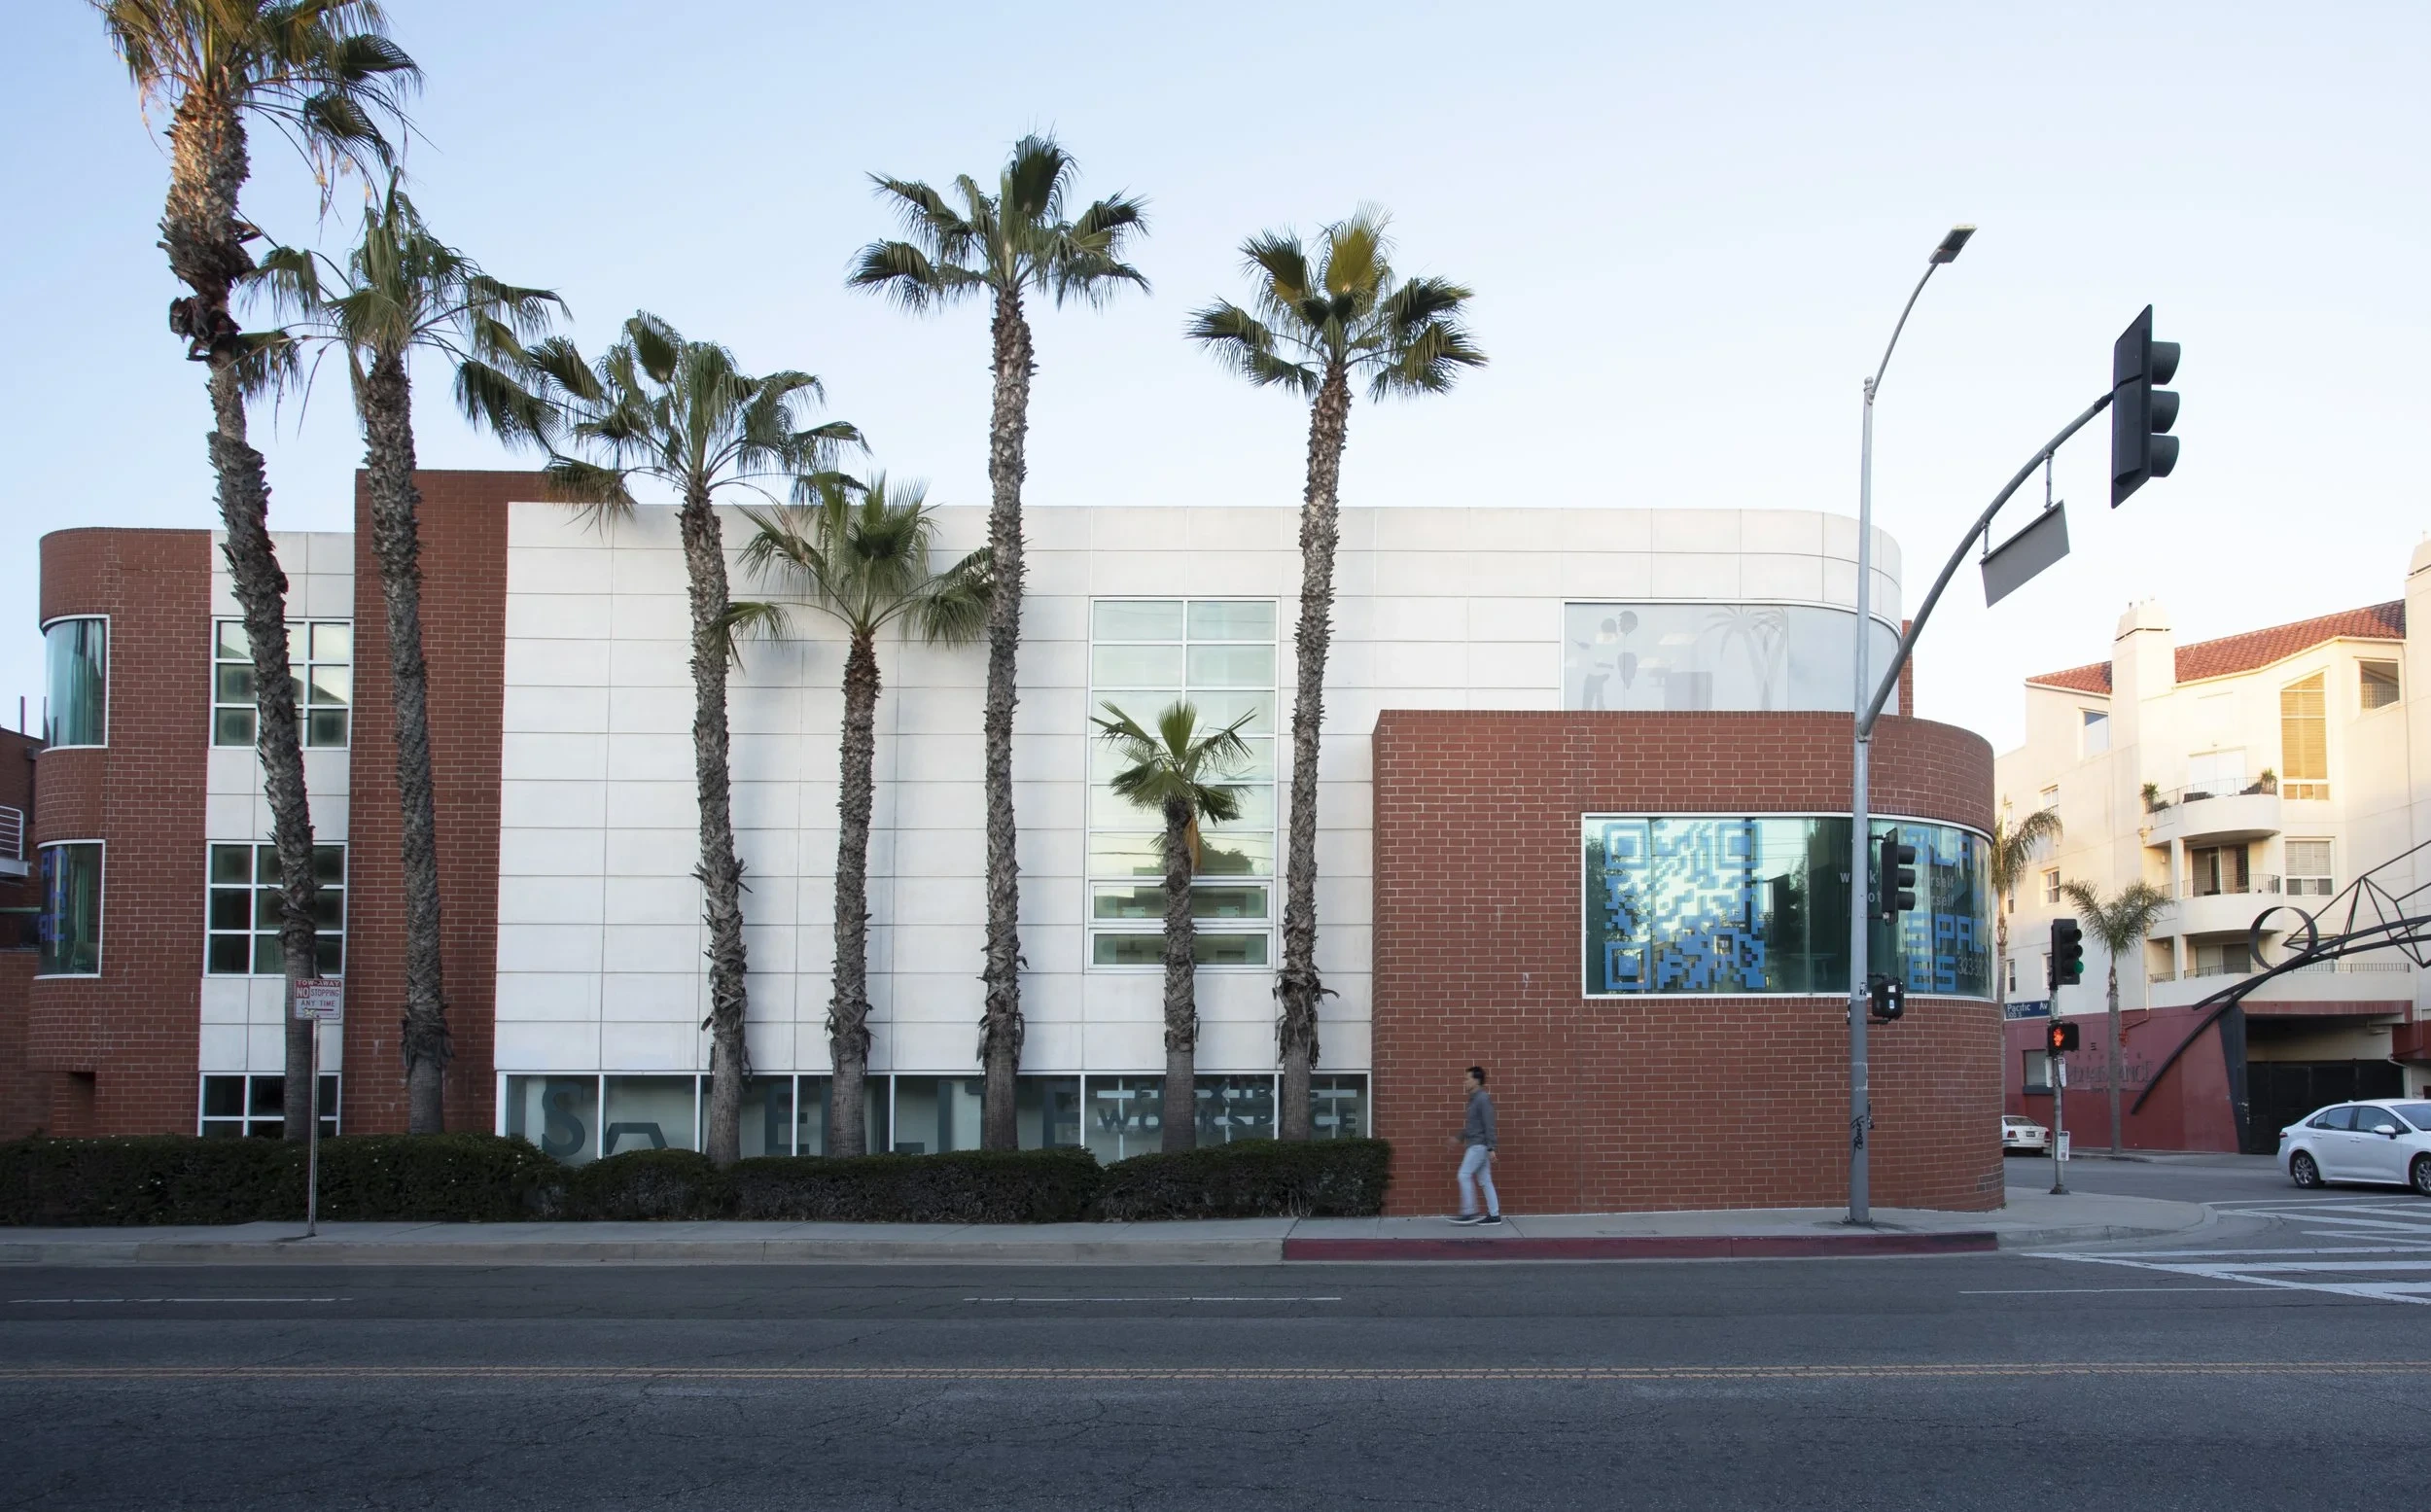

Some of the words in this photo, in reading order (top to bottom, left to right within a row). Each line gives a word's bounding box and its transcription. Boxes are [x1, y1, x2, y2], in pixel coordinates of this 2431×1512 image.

[1840, 869, 1877, 884] wk
[297, 987, 309, 998] NO
[311, 988, 340, 998] STOPPING
[2007, 1002, 2031, 1012] Pacific
[2039, 1002, 2049, 1010] Av
[1098, 1107, 1357, 1135] WOKSPCE
